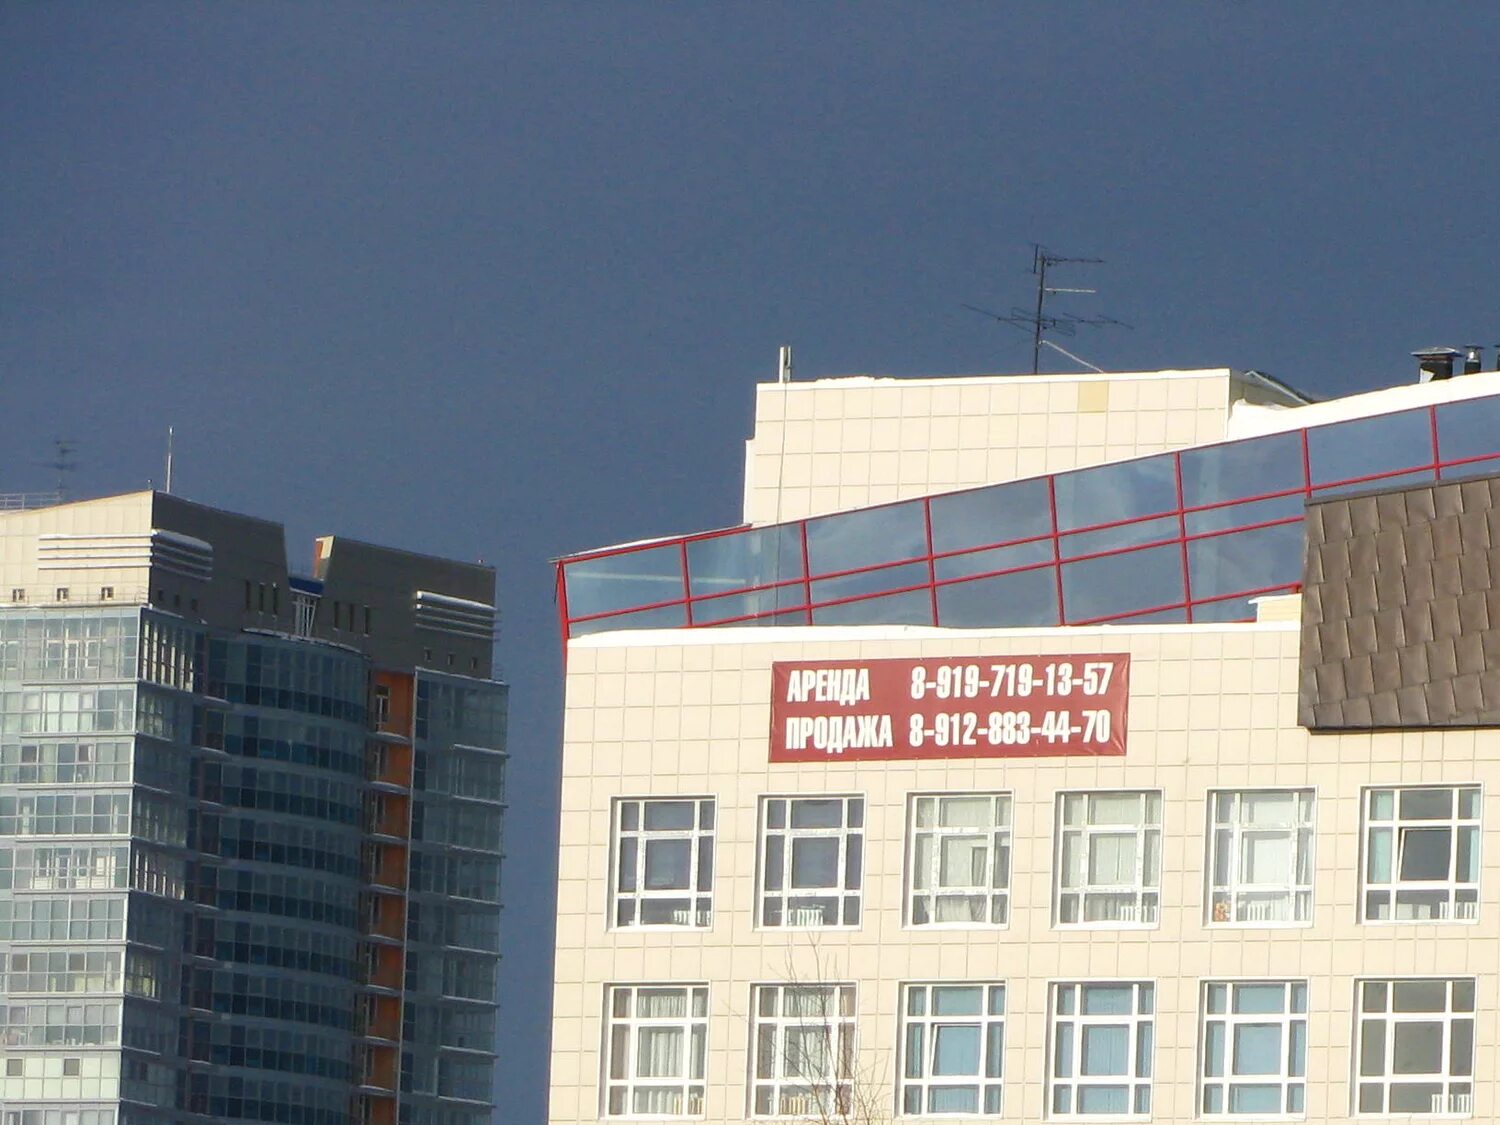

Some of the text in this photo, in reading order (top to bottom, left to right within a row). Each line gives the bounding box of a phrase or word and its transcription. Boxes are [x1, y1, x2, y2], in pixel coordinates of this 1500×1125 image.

[786, 662, 1115, 706] АРЕНДА 8-919-719-13-57
[785, 709, 1112, 754] ПРОДАЖА 8-912-883-44-70
